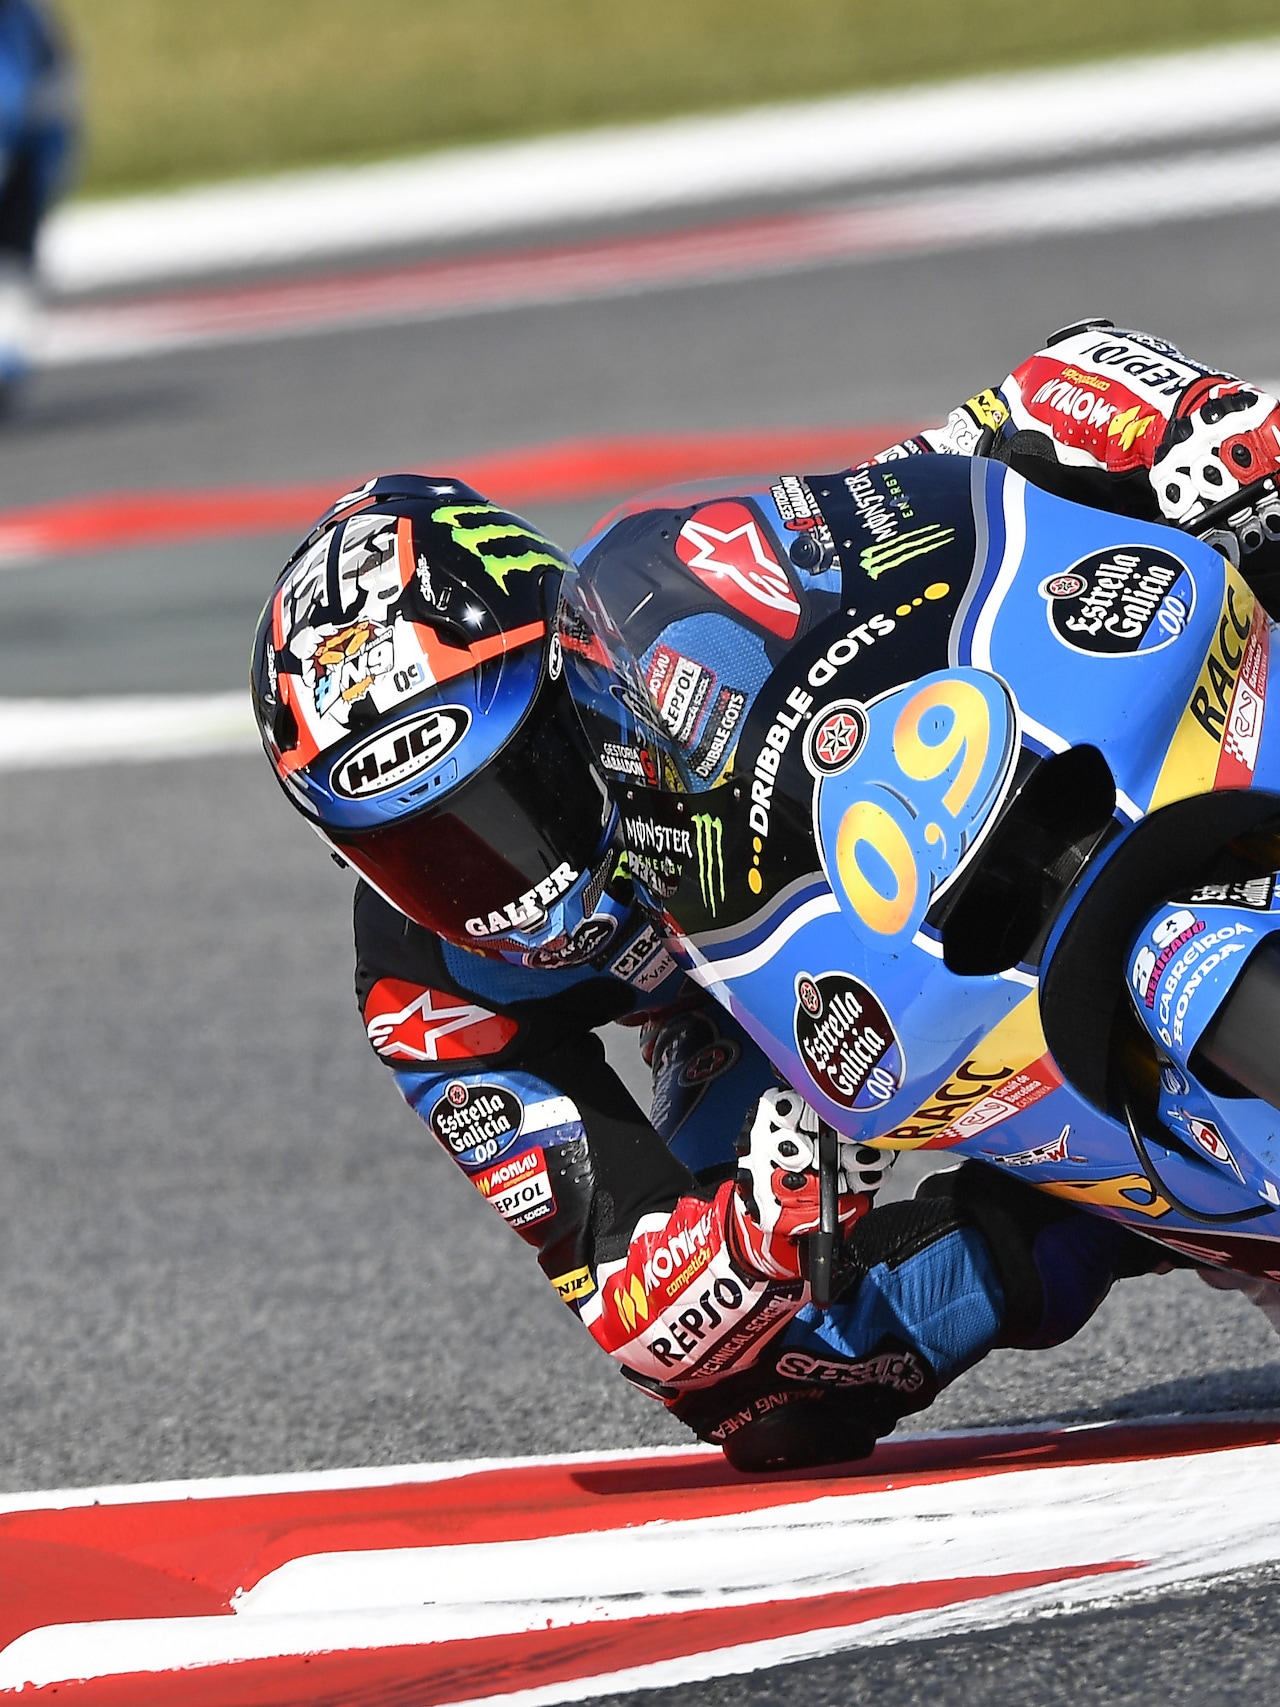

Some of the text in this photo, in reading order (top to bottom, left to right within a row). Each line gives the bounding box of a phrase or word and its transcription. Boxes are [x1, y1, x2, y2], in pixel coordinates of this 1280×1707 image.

[844, 469, 898, 542] MONSTER
[1065, 554, 1141, 636] Estrella
[1104, 565, 1175, 639] Galicia
[1189, 585, 1250, 743] RACC
[347, 716, 442, 792] HJC
[695, 727, 731, 777] DRIBBLE
[750, 686, 813, 837] DRIBBLE
[807, 613, 896, 687] DOTS
[625, 814, 693, 858] MONSTER
[464, 861, 579, 936] GALFER
[1145, 920, 1206, 1010] MEXICANO
[1173, 943, 1245, 1046] HONDA
[803, 991, 863, 1073] Estrella
[826, 1026, 886, 1096] Galicia
[436, 1094, 505, 1134] Estrella
[449, 1115, 511, 1152] Galicia
[883, 1061, 1014, 1138] RACC
[490, 1182, 545, 1214] EPSOL
[690, 1333, 756, 1378] TECHNICAL
